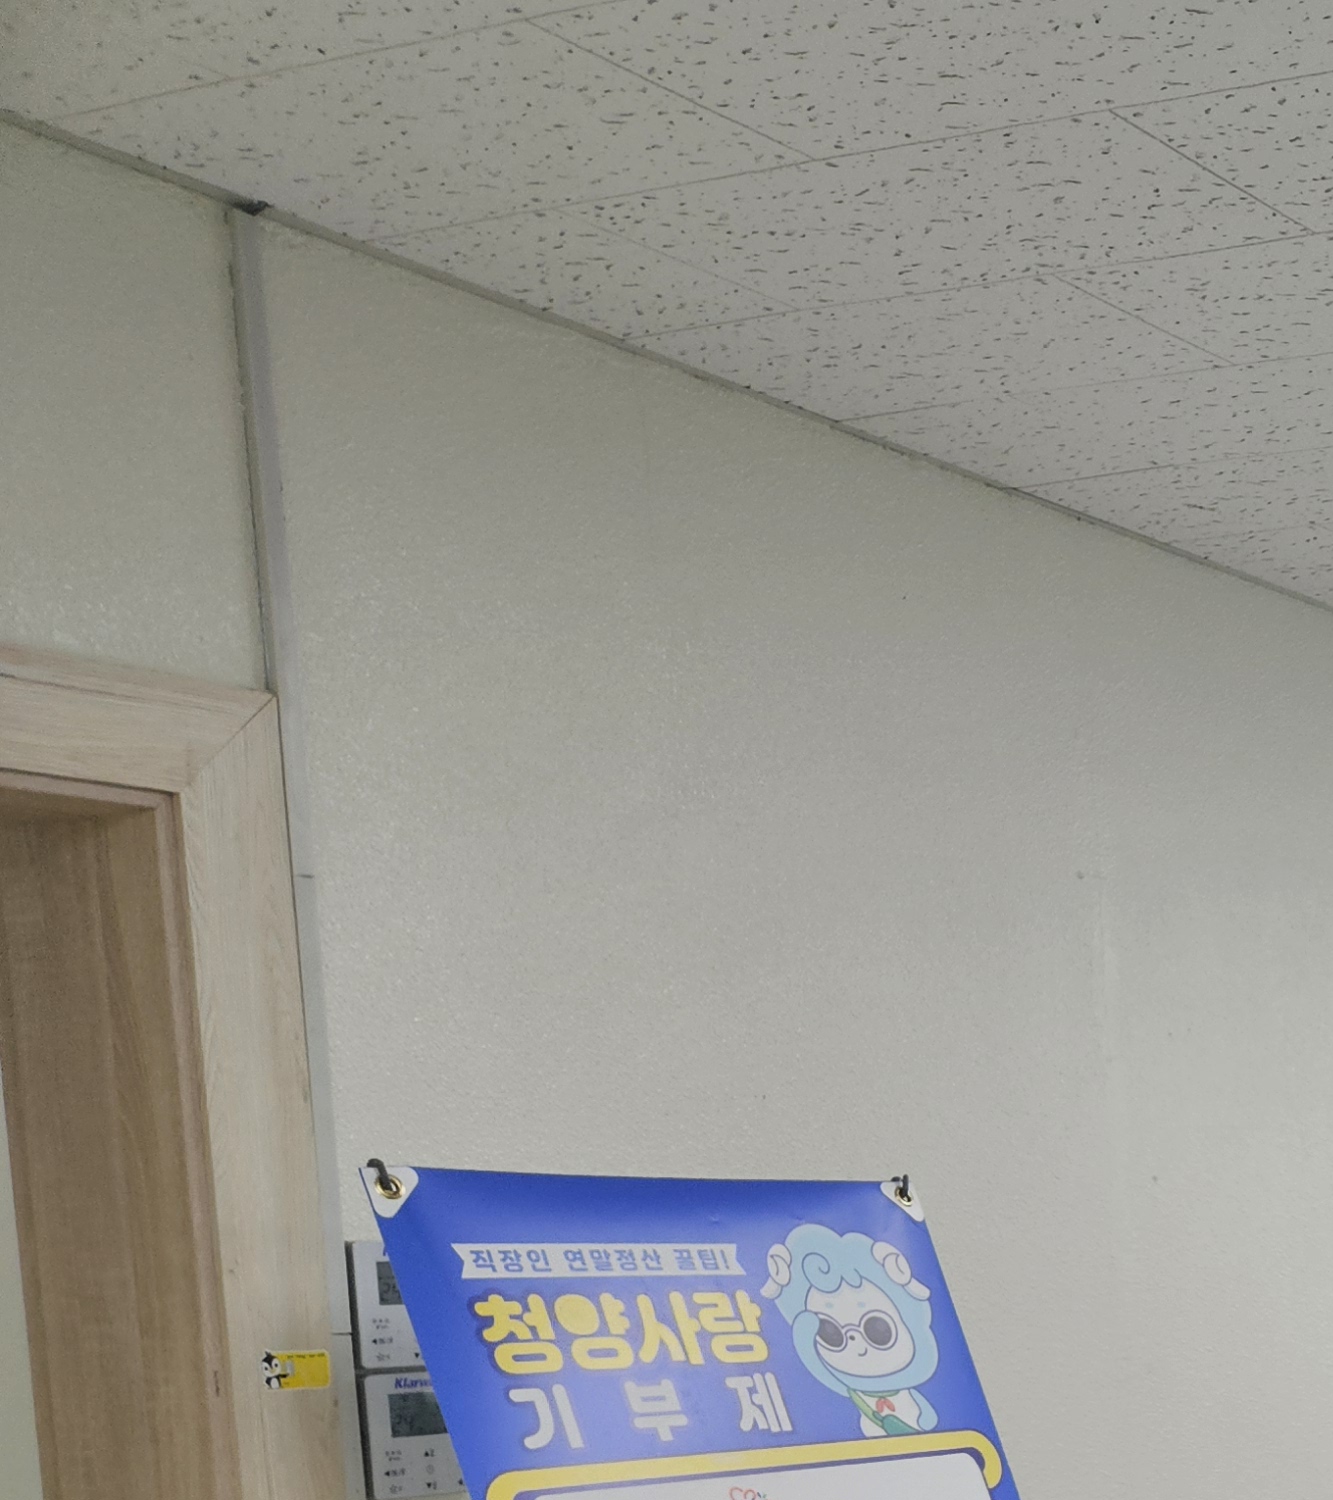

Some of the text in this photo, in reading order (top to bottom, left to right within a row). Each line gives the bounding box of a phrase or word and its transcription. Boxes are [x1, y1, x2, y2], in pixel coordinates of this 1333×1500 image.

[470, 1248, 730, 1273] 직장인 연말정산 꿀팁!
[473, 1288, 770, 1376] 청양사랑
